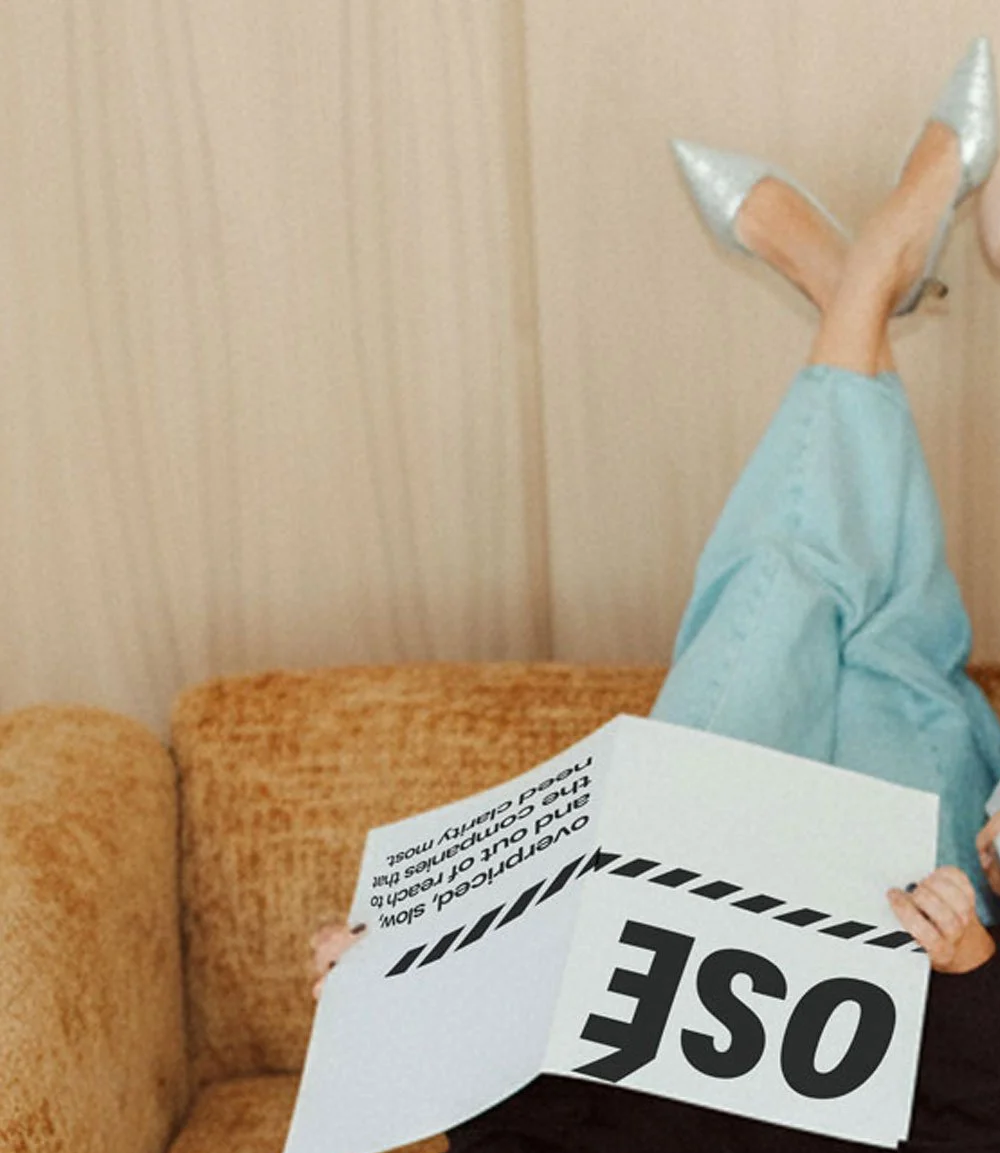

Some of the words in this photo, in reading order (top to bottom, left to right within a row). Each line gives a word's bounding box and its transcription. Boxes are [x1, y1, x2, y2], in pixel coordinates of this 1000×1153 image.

[518, 757, 593, 804] need
[542, 775, 591, 805] the
[437, 800, 512, 845] clarity
[534, 792, 590, 833] and
[386, 840, 434, 867] most.
[405, 804, 534, 879] companies
[481, 829, 527, 859] out
[432, 815, 590, 911] overpriced,
[447, 855, 474, 879] of
[372, 870, 400, 888] that
[387, 872, 443, 906] reach
[370, 896, 383, 909] to
[378, 903, 426, 929] slow,
